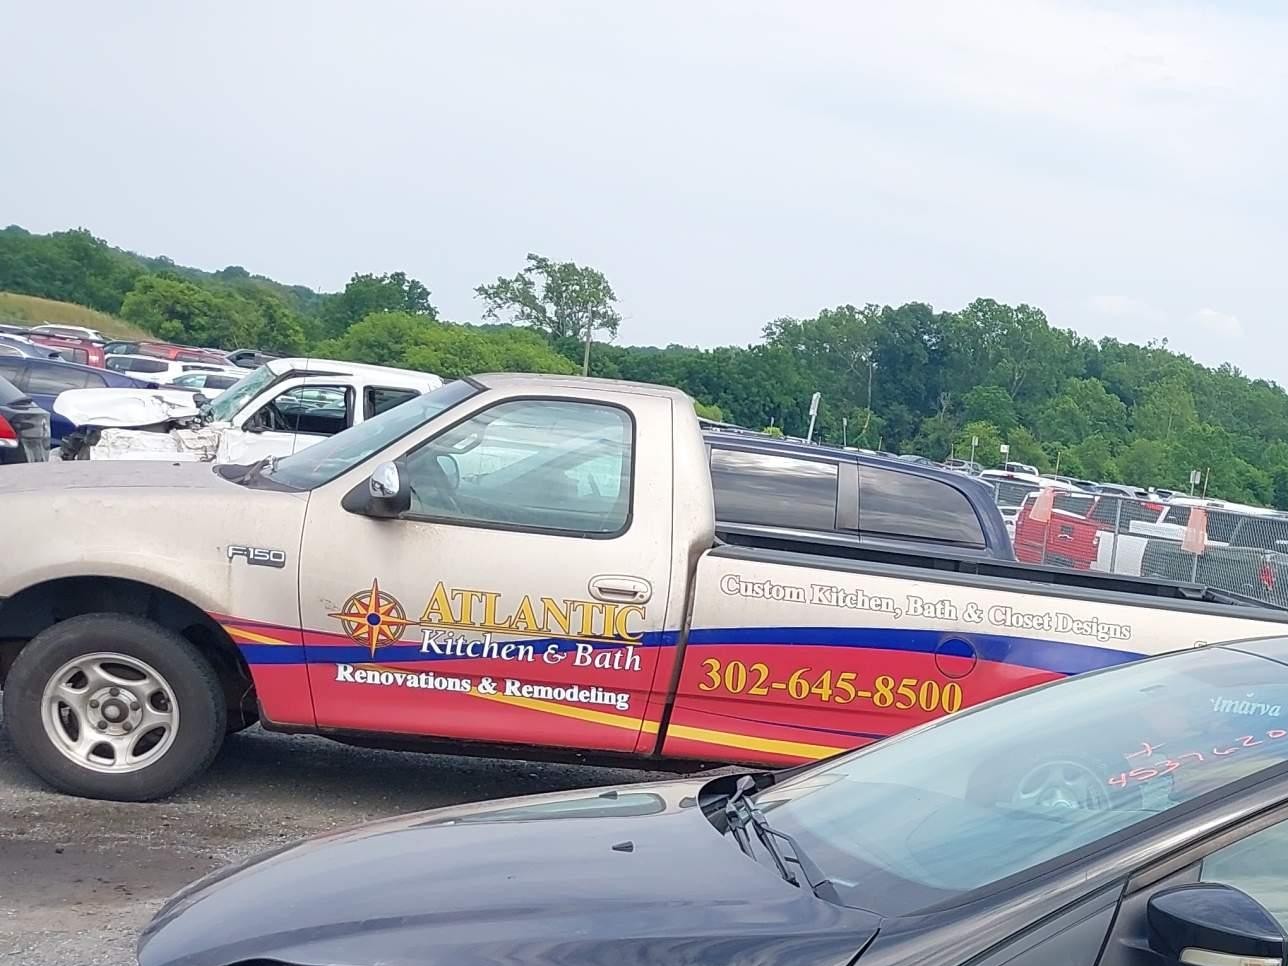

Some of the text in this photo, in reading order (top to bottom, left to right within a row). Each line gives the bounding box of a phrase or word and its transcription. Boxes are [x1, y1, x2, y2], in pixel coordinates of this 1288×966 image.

[228, 545, 286, 562] F-150
[419, 581, 647, 641] ATLANTIC
[720, 574, 1132, 641] Custom Kitchen, Bath & Closet Designs
[420, 628, 642, 672] Kitchen & Bath
[336, 663, 630, 710] Renovations & Remodeling
[698, 657, 963, 713] 302-645-8500
